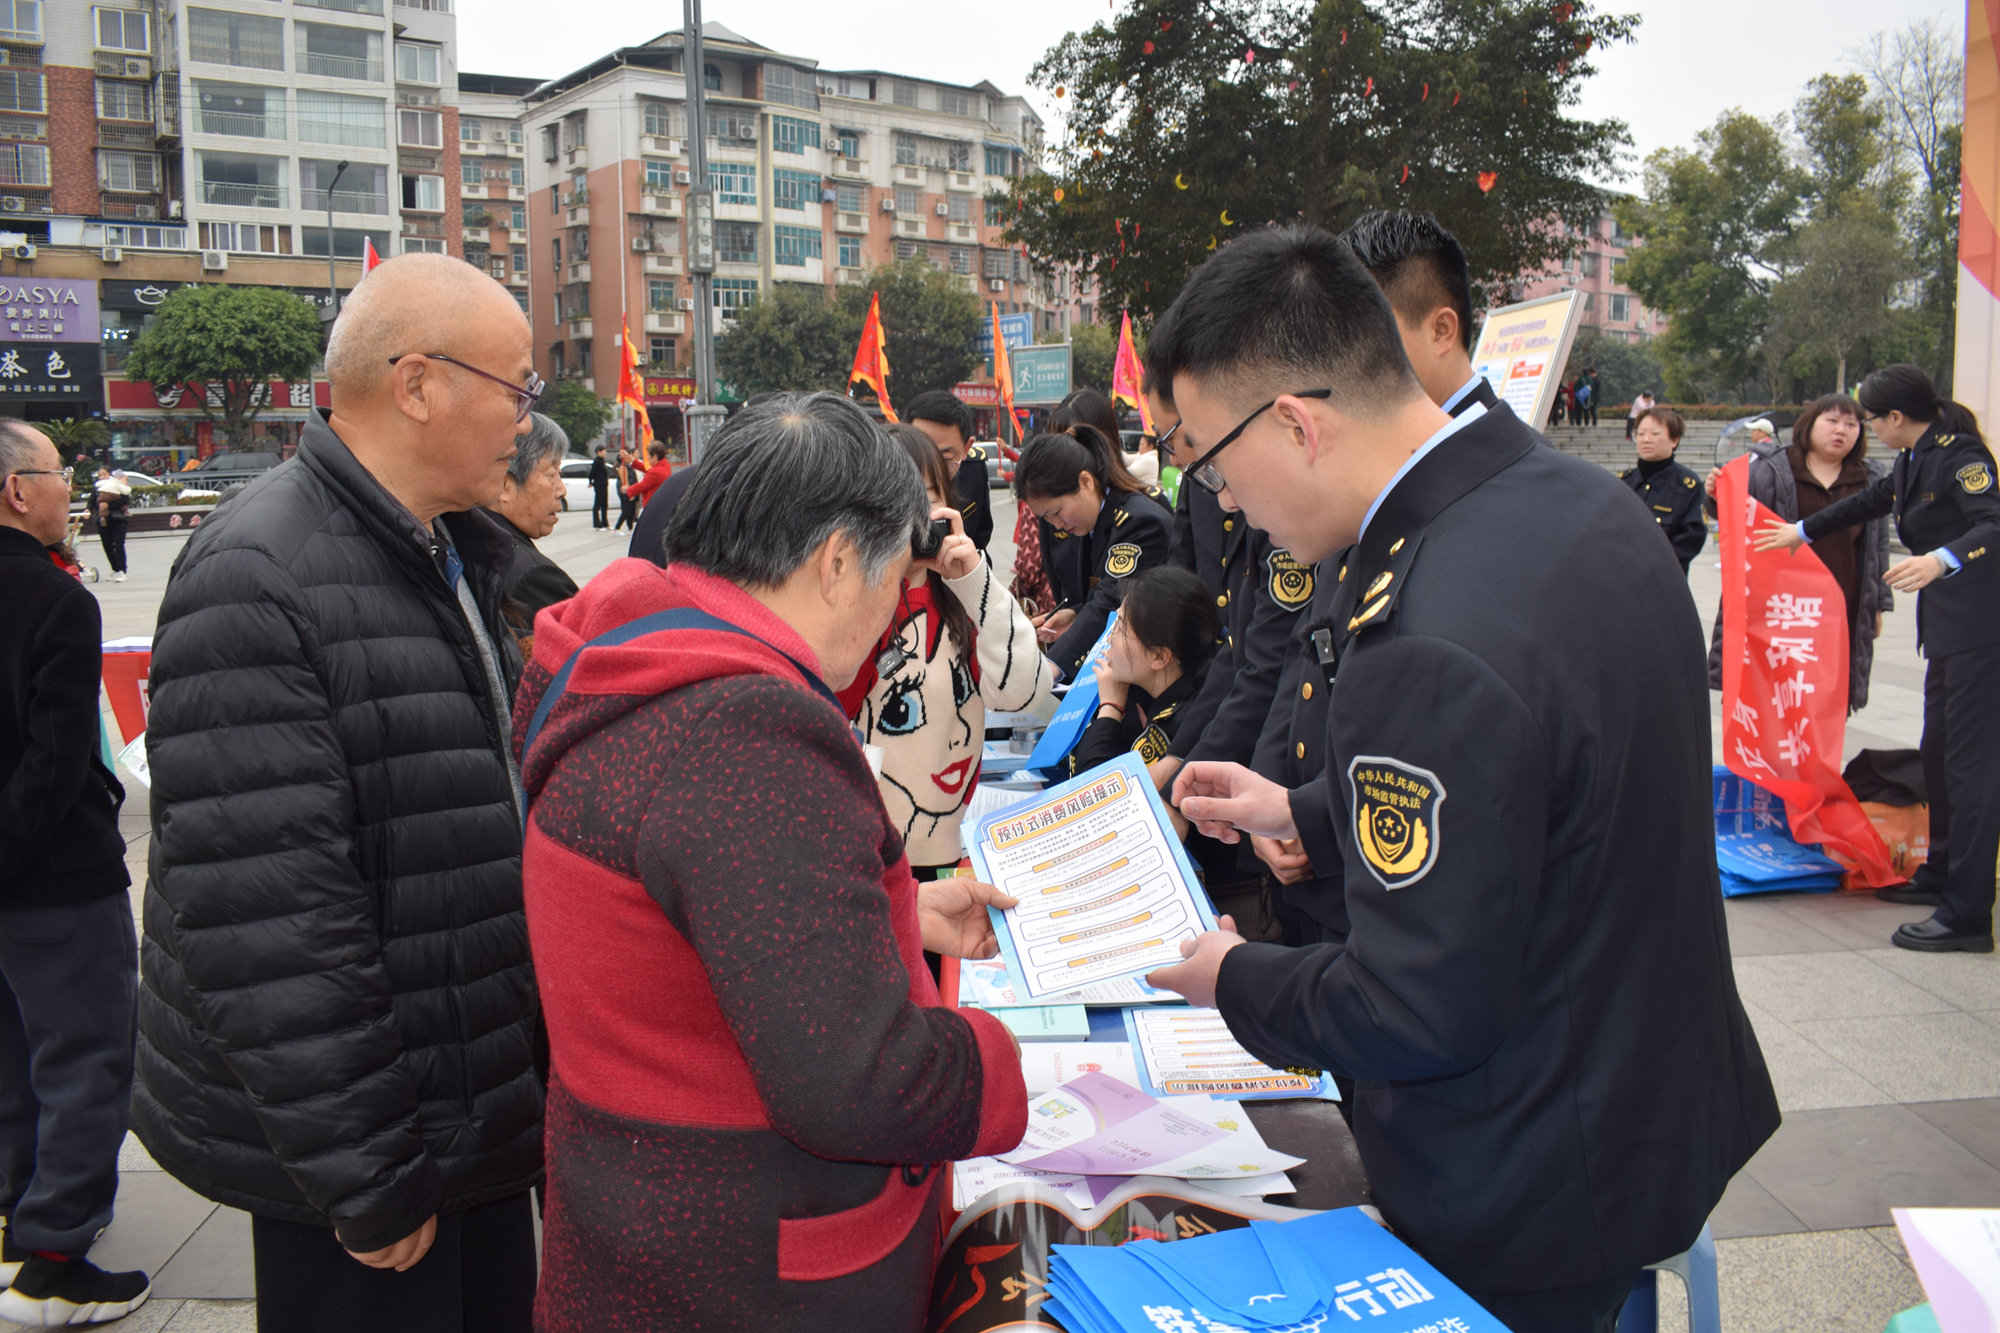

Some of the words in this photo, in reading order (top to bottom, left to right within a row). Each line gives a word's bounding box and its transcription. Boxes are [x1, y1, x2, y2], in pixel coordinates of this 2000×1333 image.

[0, 349, 72, 379] 茶色
[1765, 592, 1824, 767] 共享和谐
[1357, 769, 1431, 800] 中华人民共和国
[1364, 784, 1421, 809] 市场监管执法
[996, 777, 1122, 843] 预付式消费风险提示
[1334, 1267, 1435, 1321] 行动
